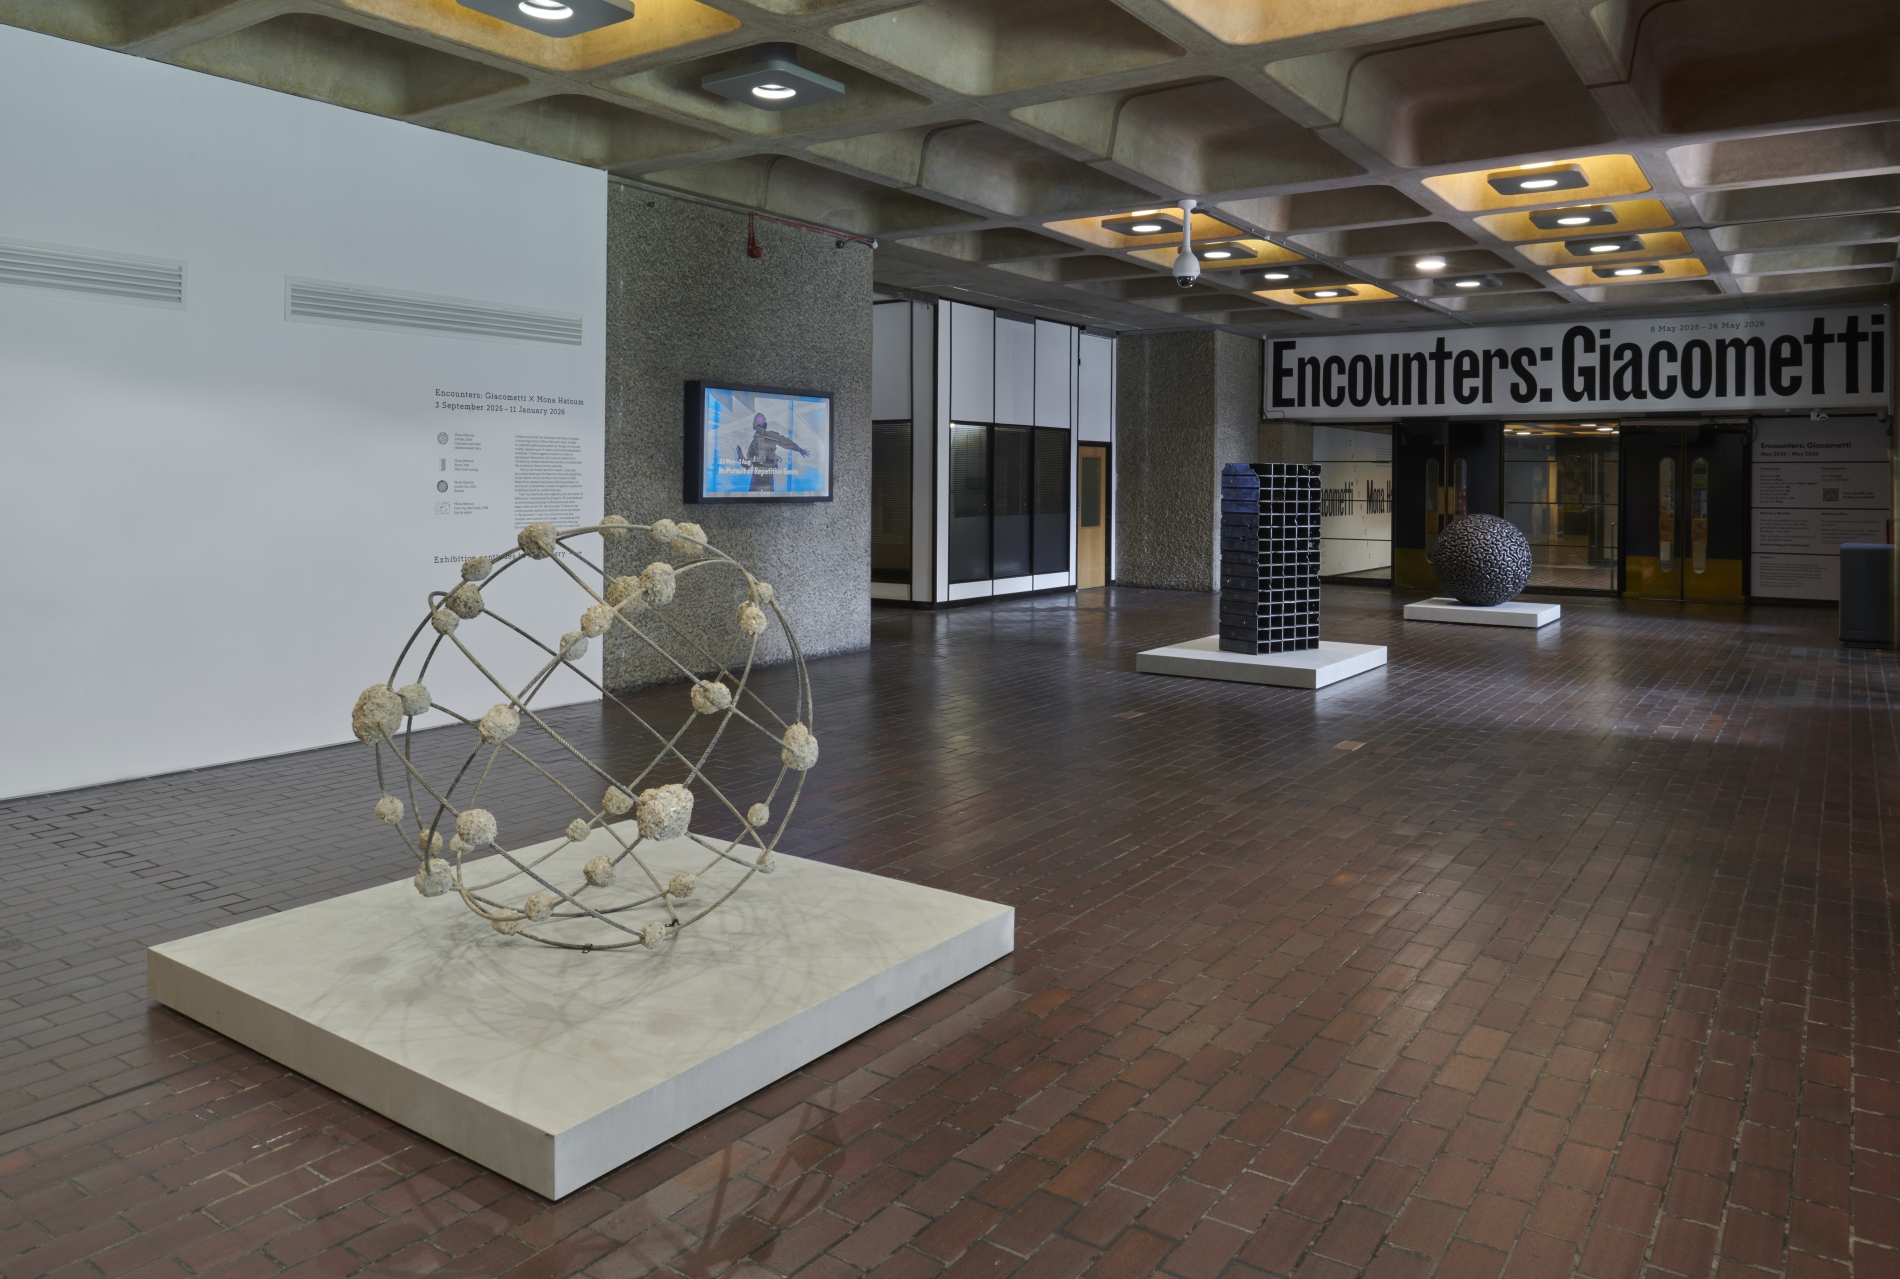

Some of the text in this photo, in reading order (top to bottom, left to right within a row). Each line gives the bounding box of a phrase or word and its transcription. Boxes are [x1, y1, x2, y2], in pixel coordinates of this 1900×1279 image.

[1722, 322, 1740, 330] May
[1272, 314, 1885, 407] Encounters: Giacometti
[435, 389, 483, 399] Encounters:
[485, 392, 527, 402] Giacometti
[558, 397, 584, 406] Hatoum
[442, 402, 484, 411] September
[519, 406, 547, 415] January
[754, 467, 782, 476] Repetitive
[1320, 481, 1354, 517] acometti
[1367, 480, 1385, 514] Mona
